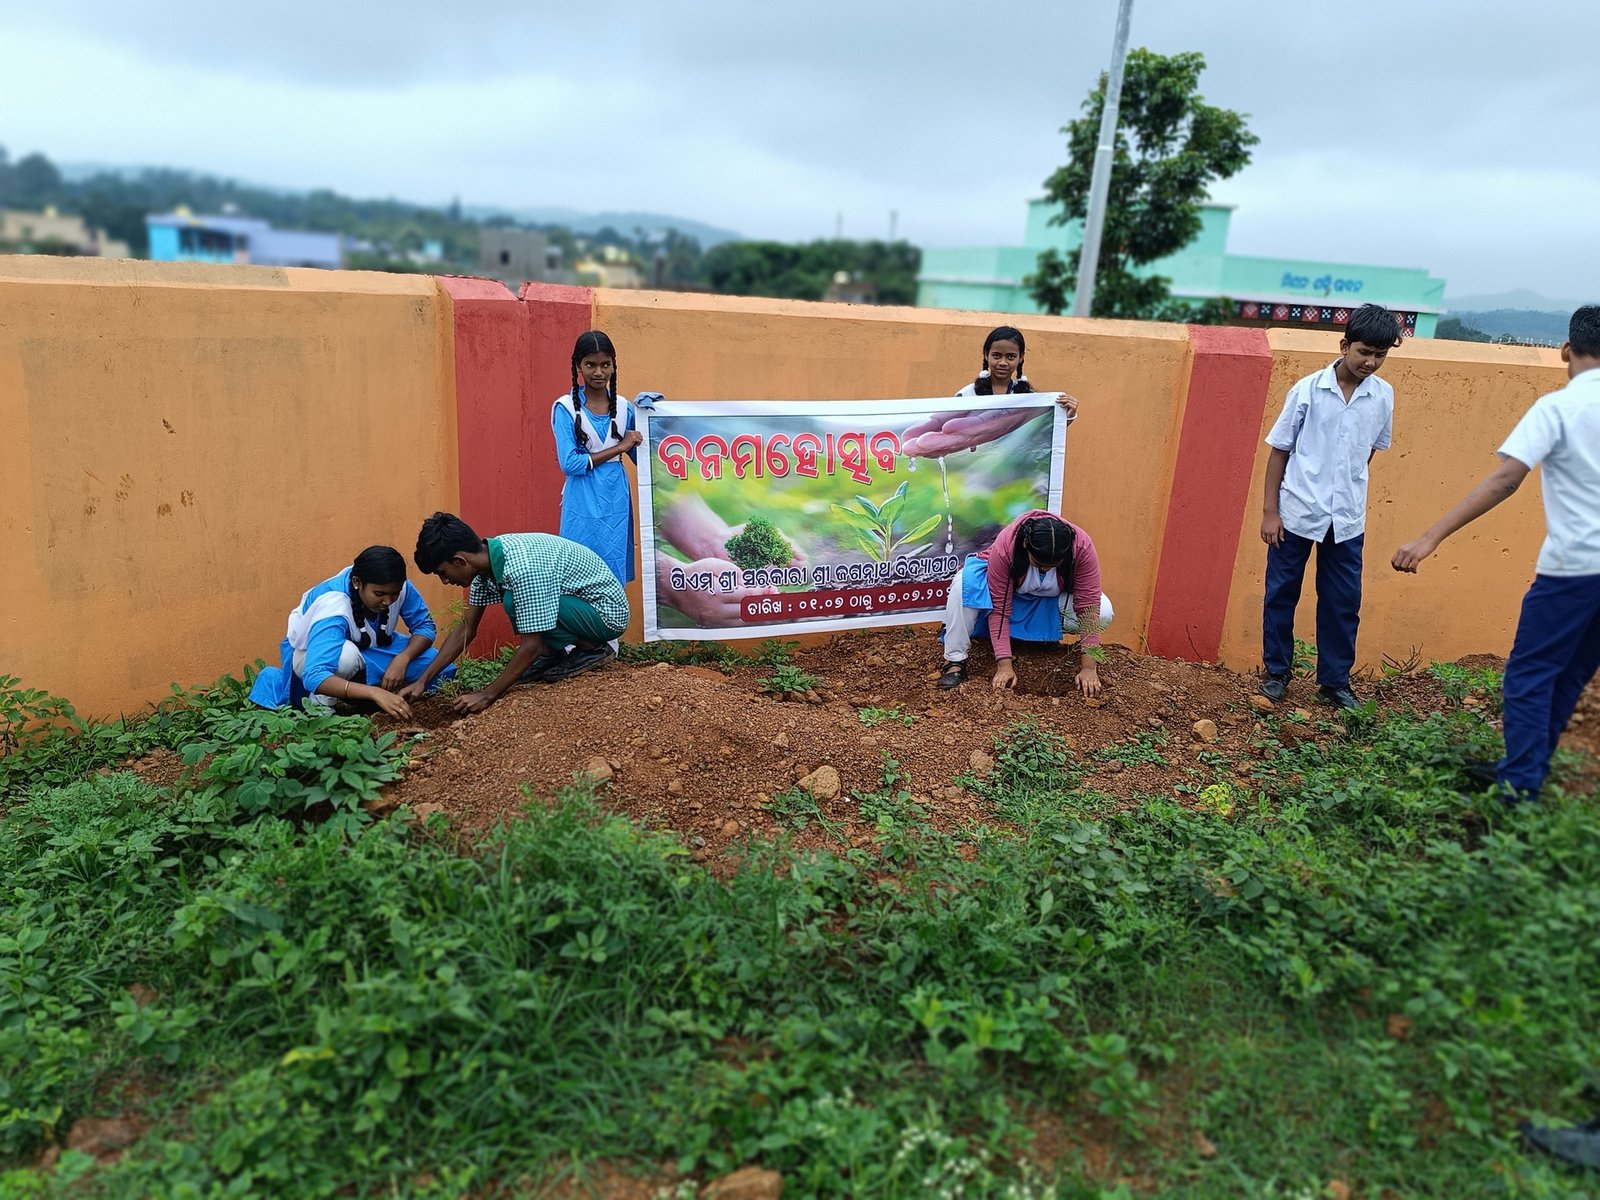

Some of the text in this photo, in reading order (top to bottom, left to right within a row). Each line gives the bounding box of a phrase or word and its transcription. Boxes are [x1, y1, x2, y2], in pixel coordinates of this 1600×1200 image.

[658, 431, 902, 485] ବନମହୋତ୍ସବ
[671, 554, 959, 596] ପିଏମ୍ ଶ୍ରୀ ସରକାରୀ ଶ୍ରୀ ଜଗନ୍ନାଥ ବିଦ୍ୟାପୀଠ
[747, 598, 782, 615] ତାରିଖ
[799, 597, 844, 611] ୦୧.୦୭
[849, 594, 873, 611] ଠାରୁ
